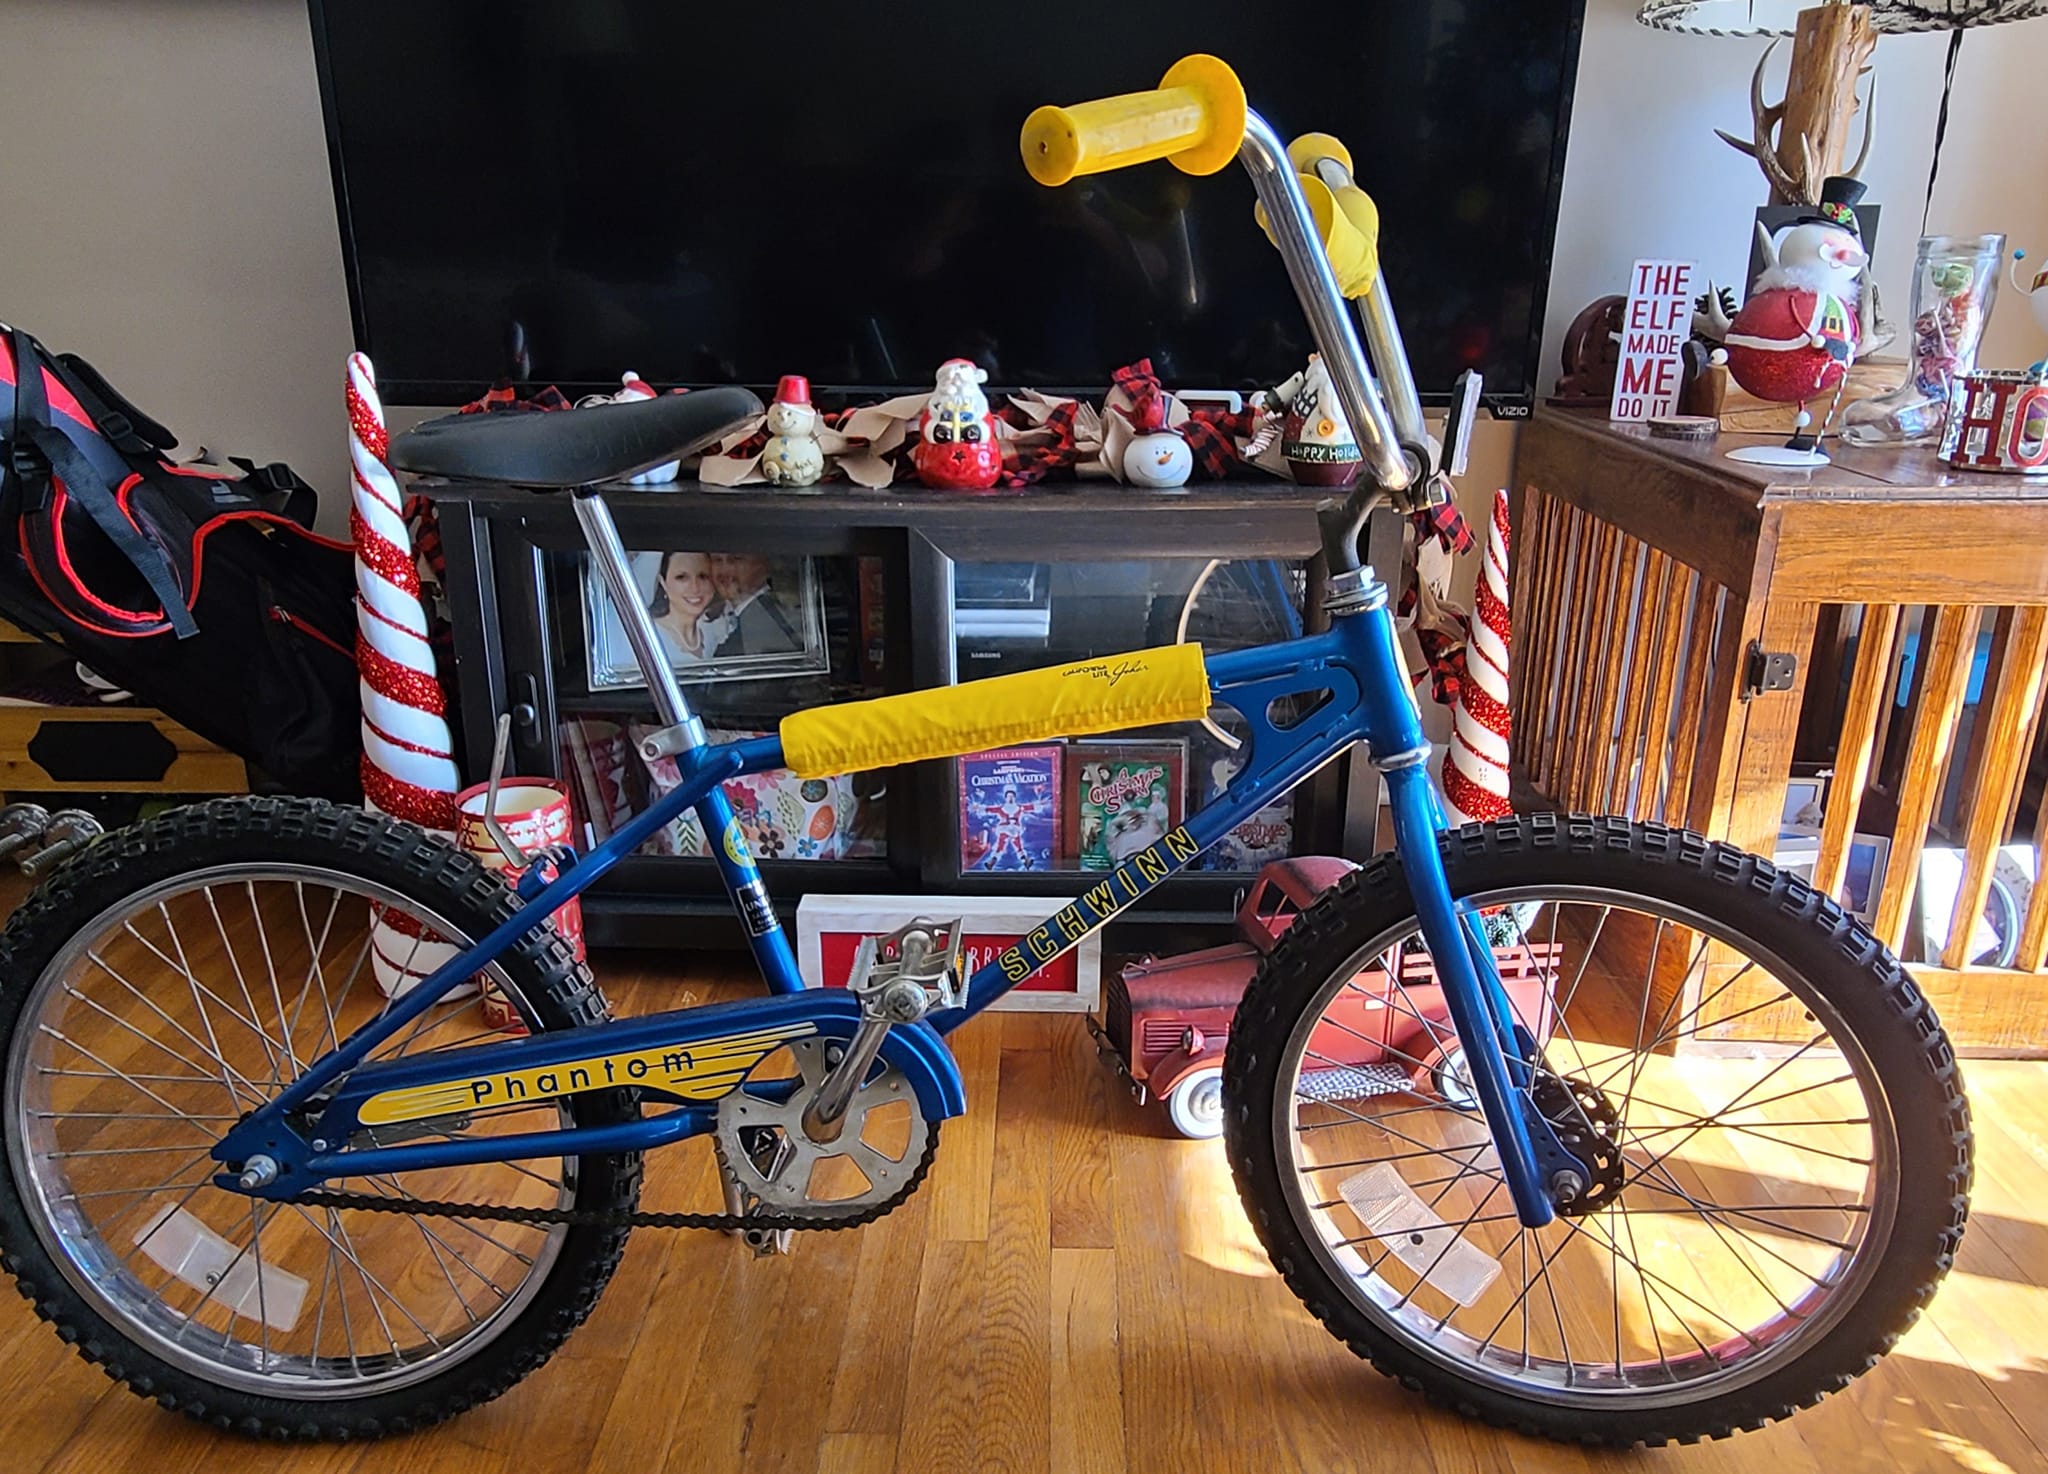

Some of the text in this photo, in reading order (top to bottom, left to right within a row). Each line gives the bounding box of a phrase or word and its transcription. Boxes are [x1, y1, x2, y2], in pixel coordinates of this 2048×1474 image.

[1638, 265, 1691, 296] THE
[1630, 300, 1686, 330] ELF
[1627, 333, 1680, 355] MADE
[1620, 357, 1677, 396] ME
[1497, 406, 1529, 417] VIZIO
[1617, 398, 1671, 418] DO IT
[998, 825, 1201, 983] SCHWINN
[471, 1048, 696, 1105] Phantom
